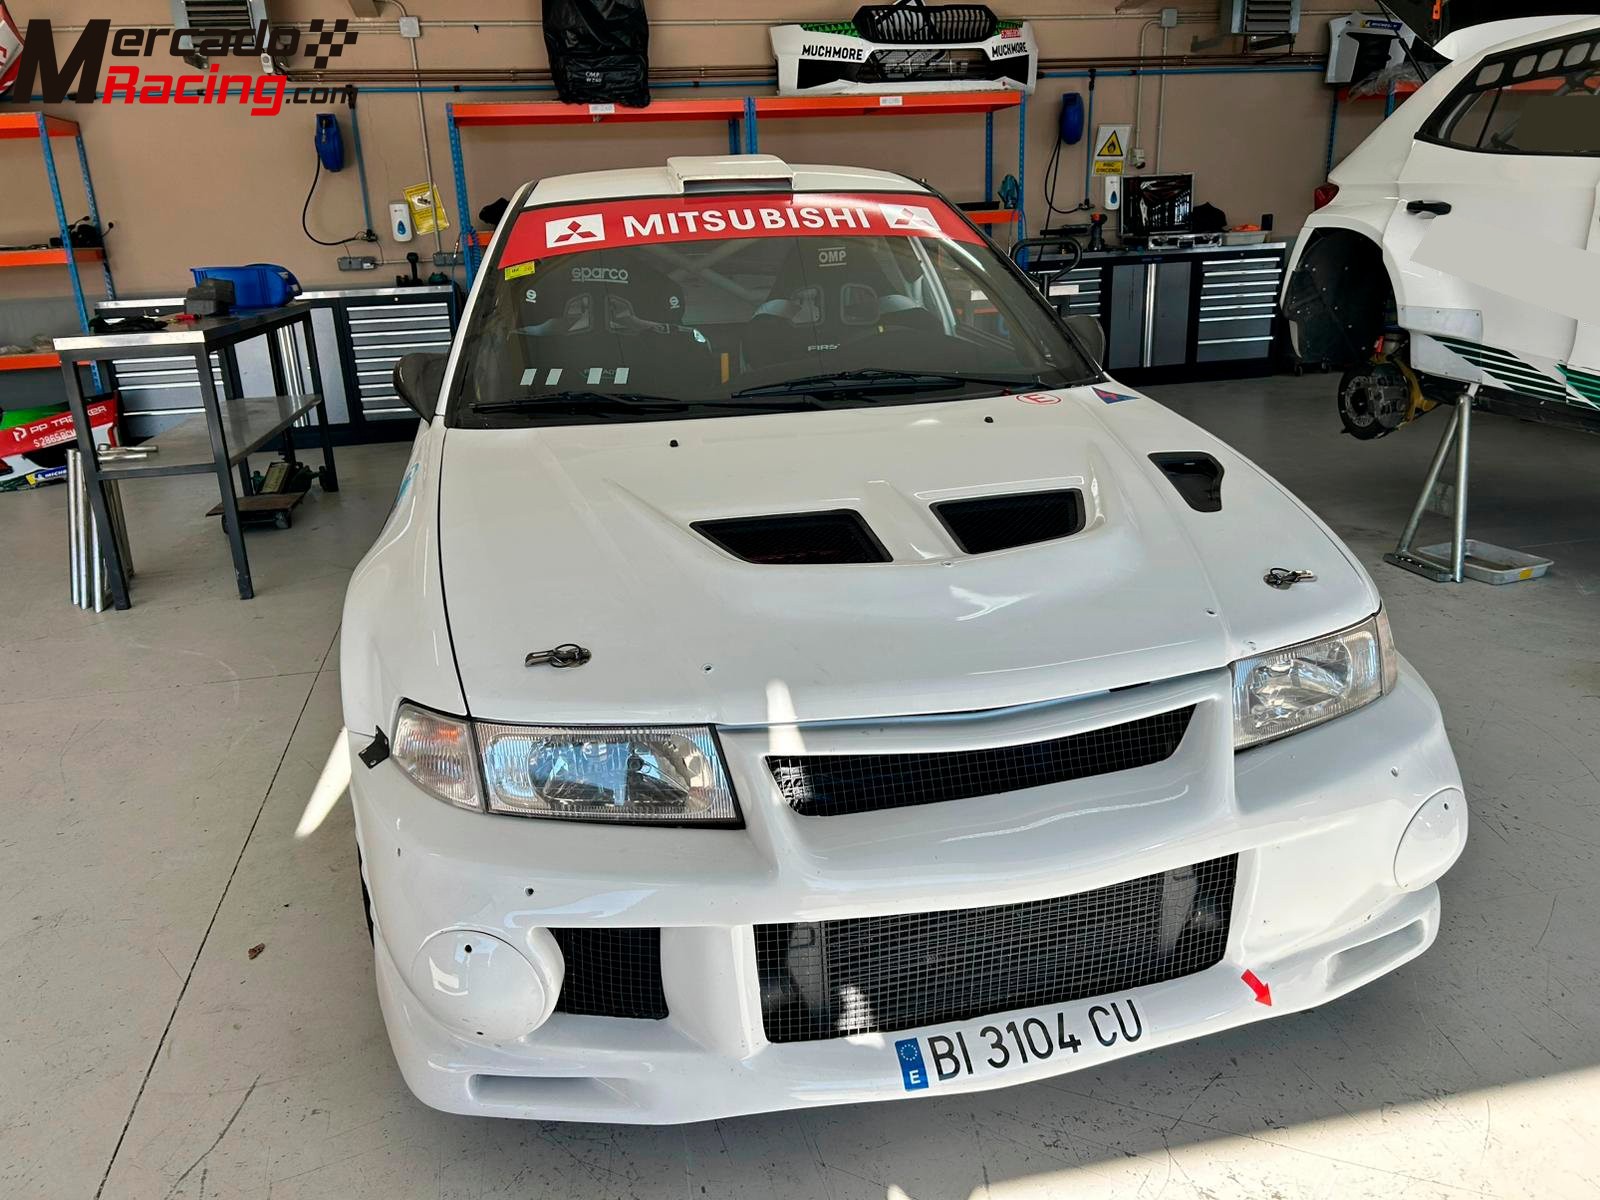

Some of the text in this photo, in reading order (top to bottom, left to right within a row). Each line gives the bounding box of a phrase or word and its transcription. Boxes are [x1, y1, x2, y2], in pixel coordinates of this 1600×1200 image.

[801, 44, 864, 60] MUCHMORE
[991, 42, 1028, 58] MUCHMORE
[623, 207, 871, 238] MITSUBISHI
[818, 249, 847, 263] OMP
[571, 267, 629, 282] sparco
[928, 999, 1142, 1081] BI 3104 CU
[909, 1070, 921, 1085] E
